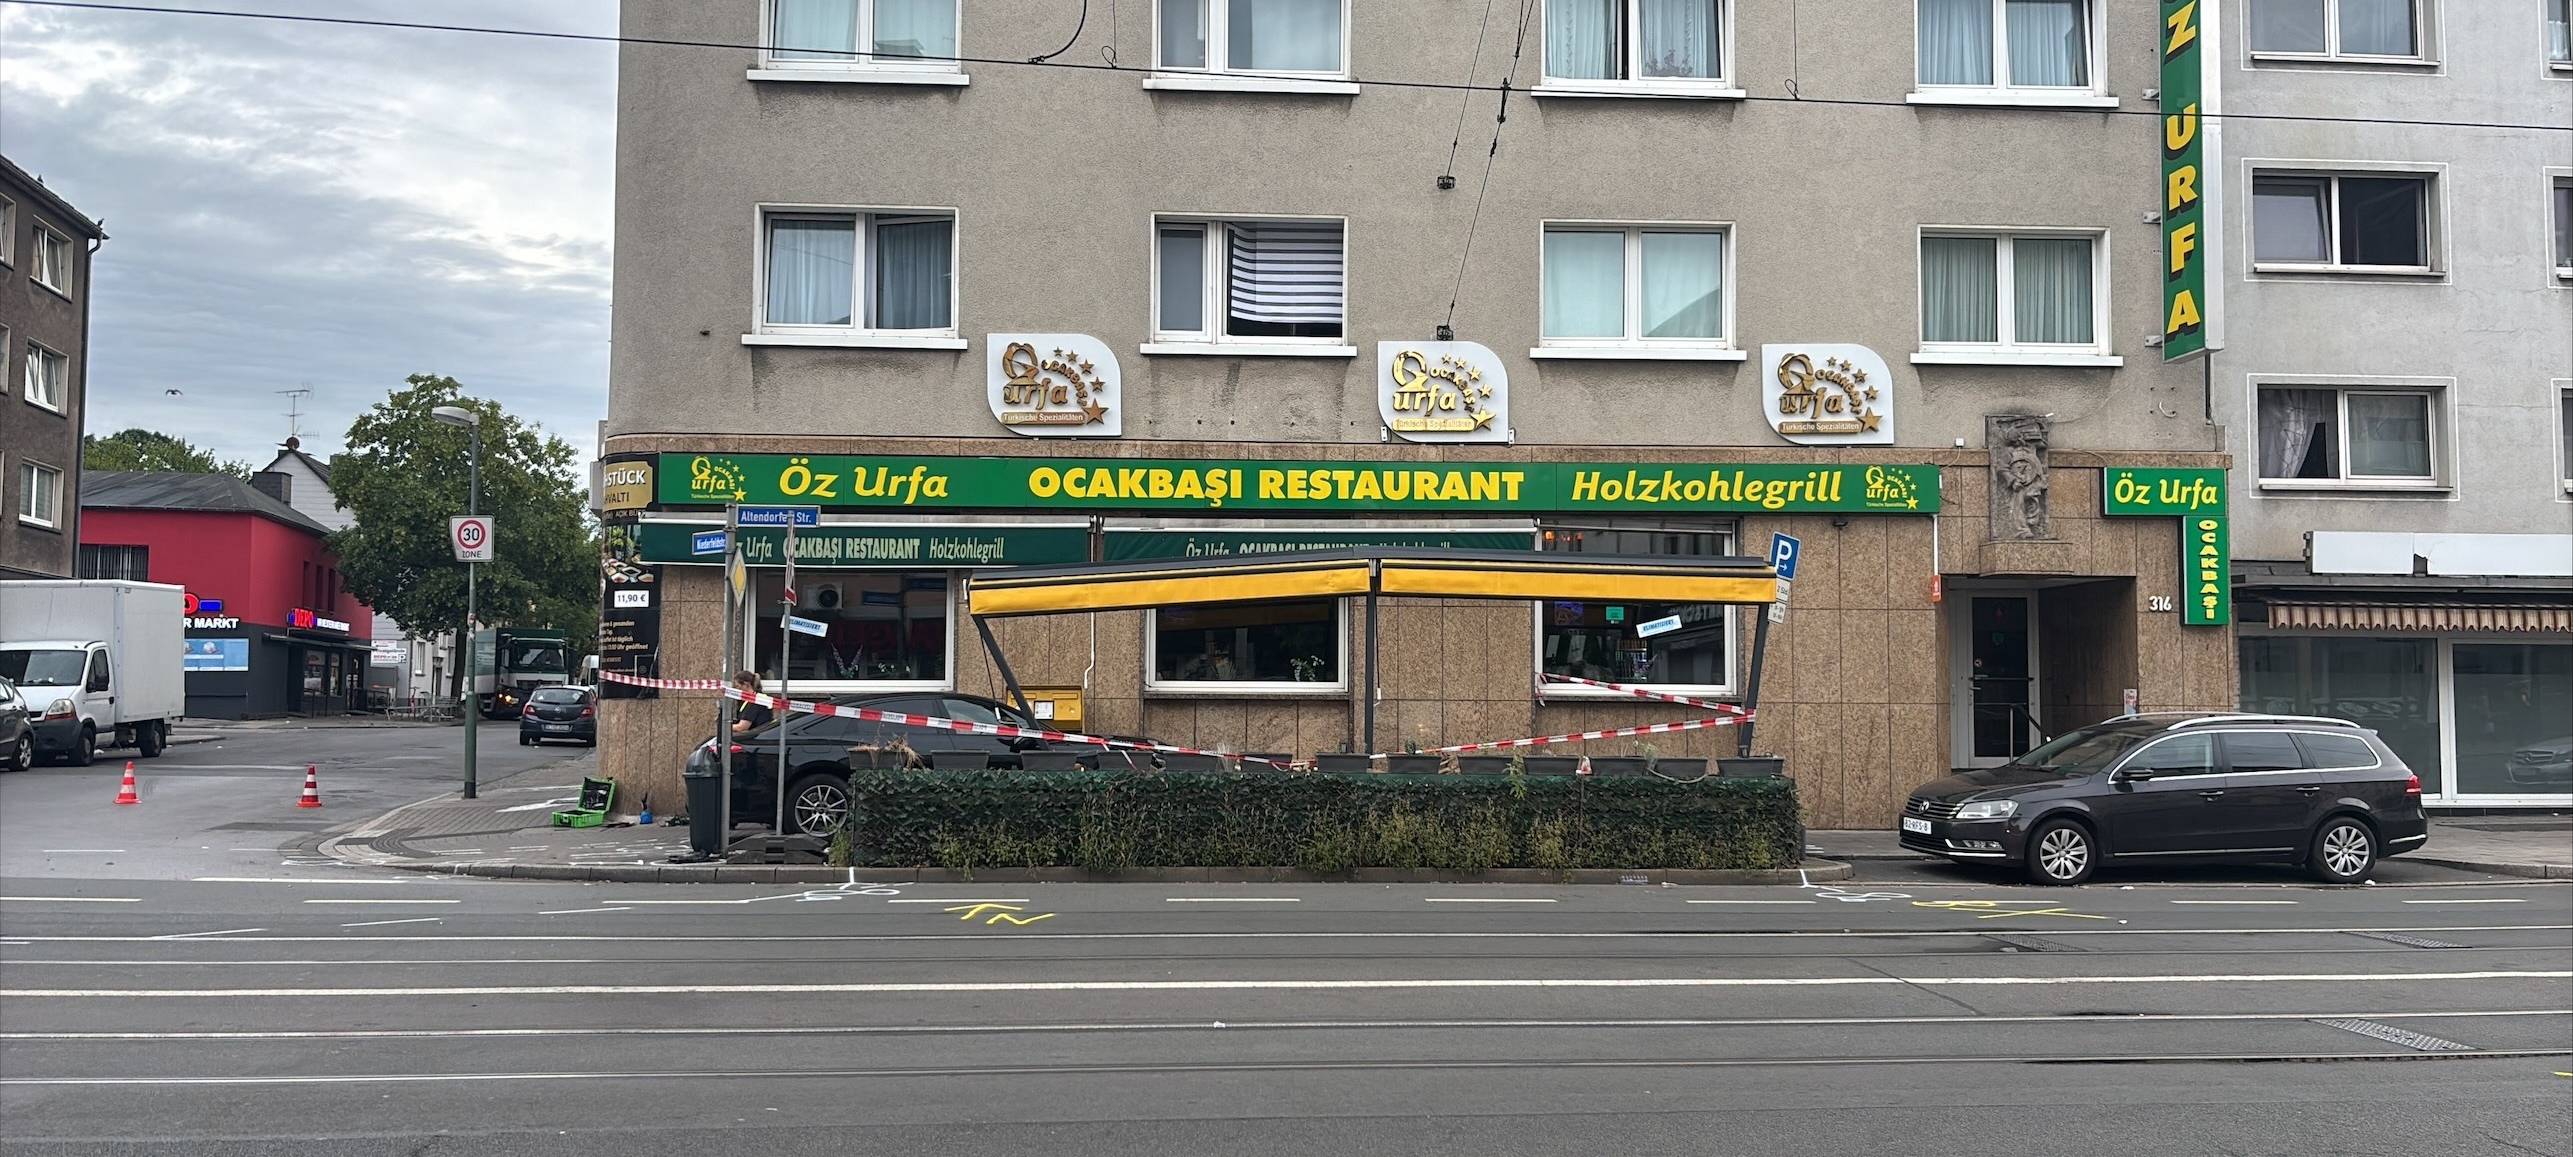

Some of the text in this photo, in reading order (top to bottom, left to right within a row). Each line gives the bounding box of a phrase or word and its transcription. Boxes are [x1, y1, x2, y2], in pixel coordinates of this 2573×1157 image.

[2166, 0, 2200, 334] Z URFA
[692, 475, 726, 493] urfa
[779, 457, 949, 505] Öz Urfa
[1028, 467, 1525, 507] OCAKBAŞI RESTAURANT
[1571, 470, 1842, 508] Holzkohlegrill
[1866, 484, 1899, 501] urfa
[2114, 472, 2218, 510] Öz Urfa
[741, 511, 812, 523] Altendorfe Str.
[463, 528, 480, 541] 30
[746, 535, 773, 562] Urfa
[846, 538, 920, 559] RESTAURANT
[929, 537, 1004, 563] Holzkohlegrill
[1775, 539, 1792, 570] P
[617, 594, 637, 603] 11,90
[2149, 595, 2172, 611] 316
[194, 617, 240, 629] MARKT
